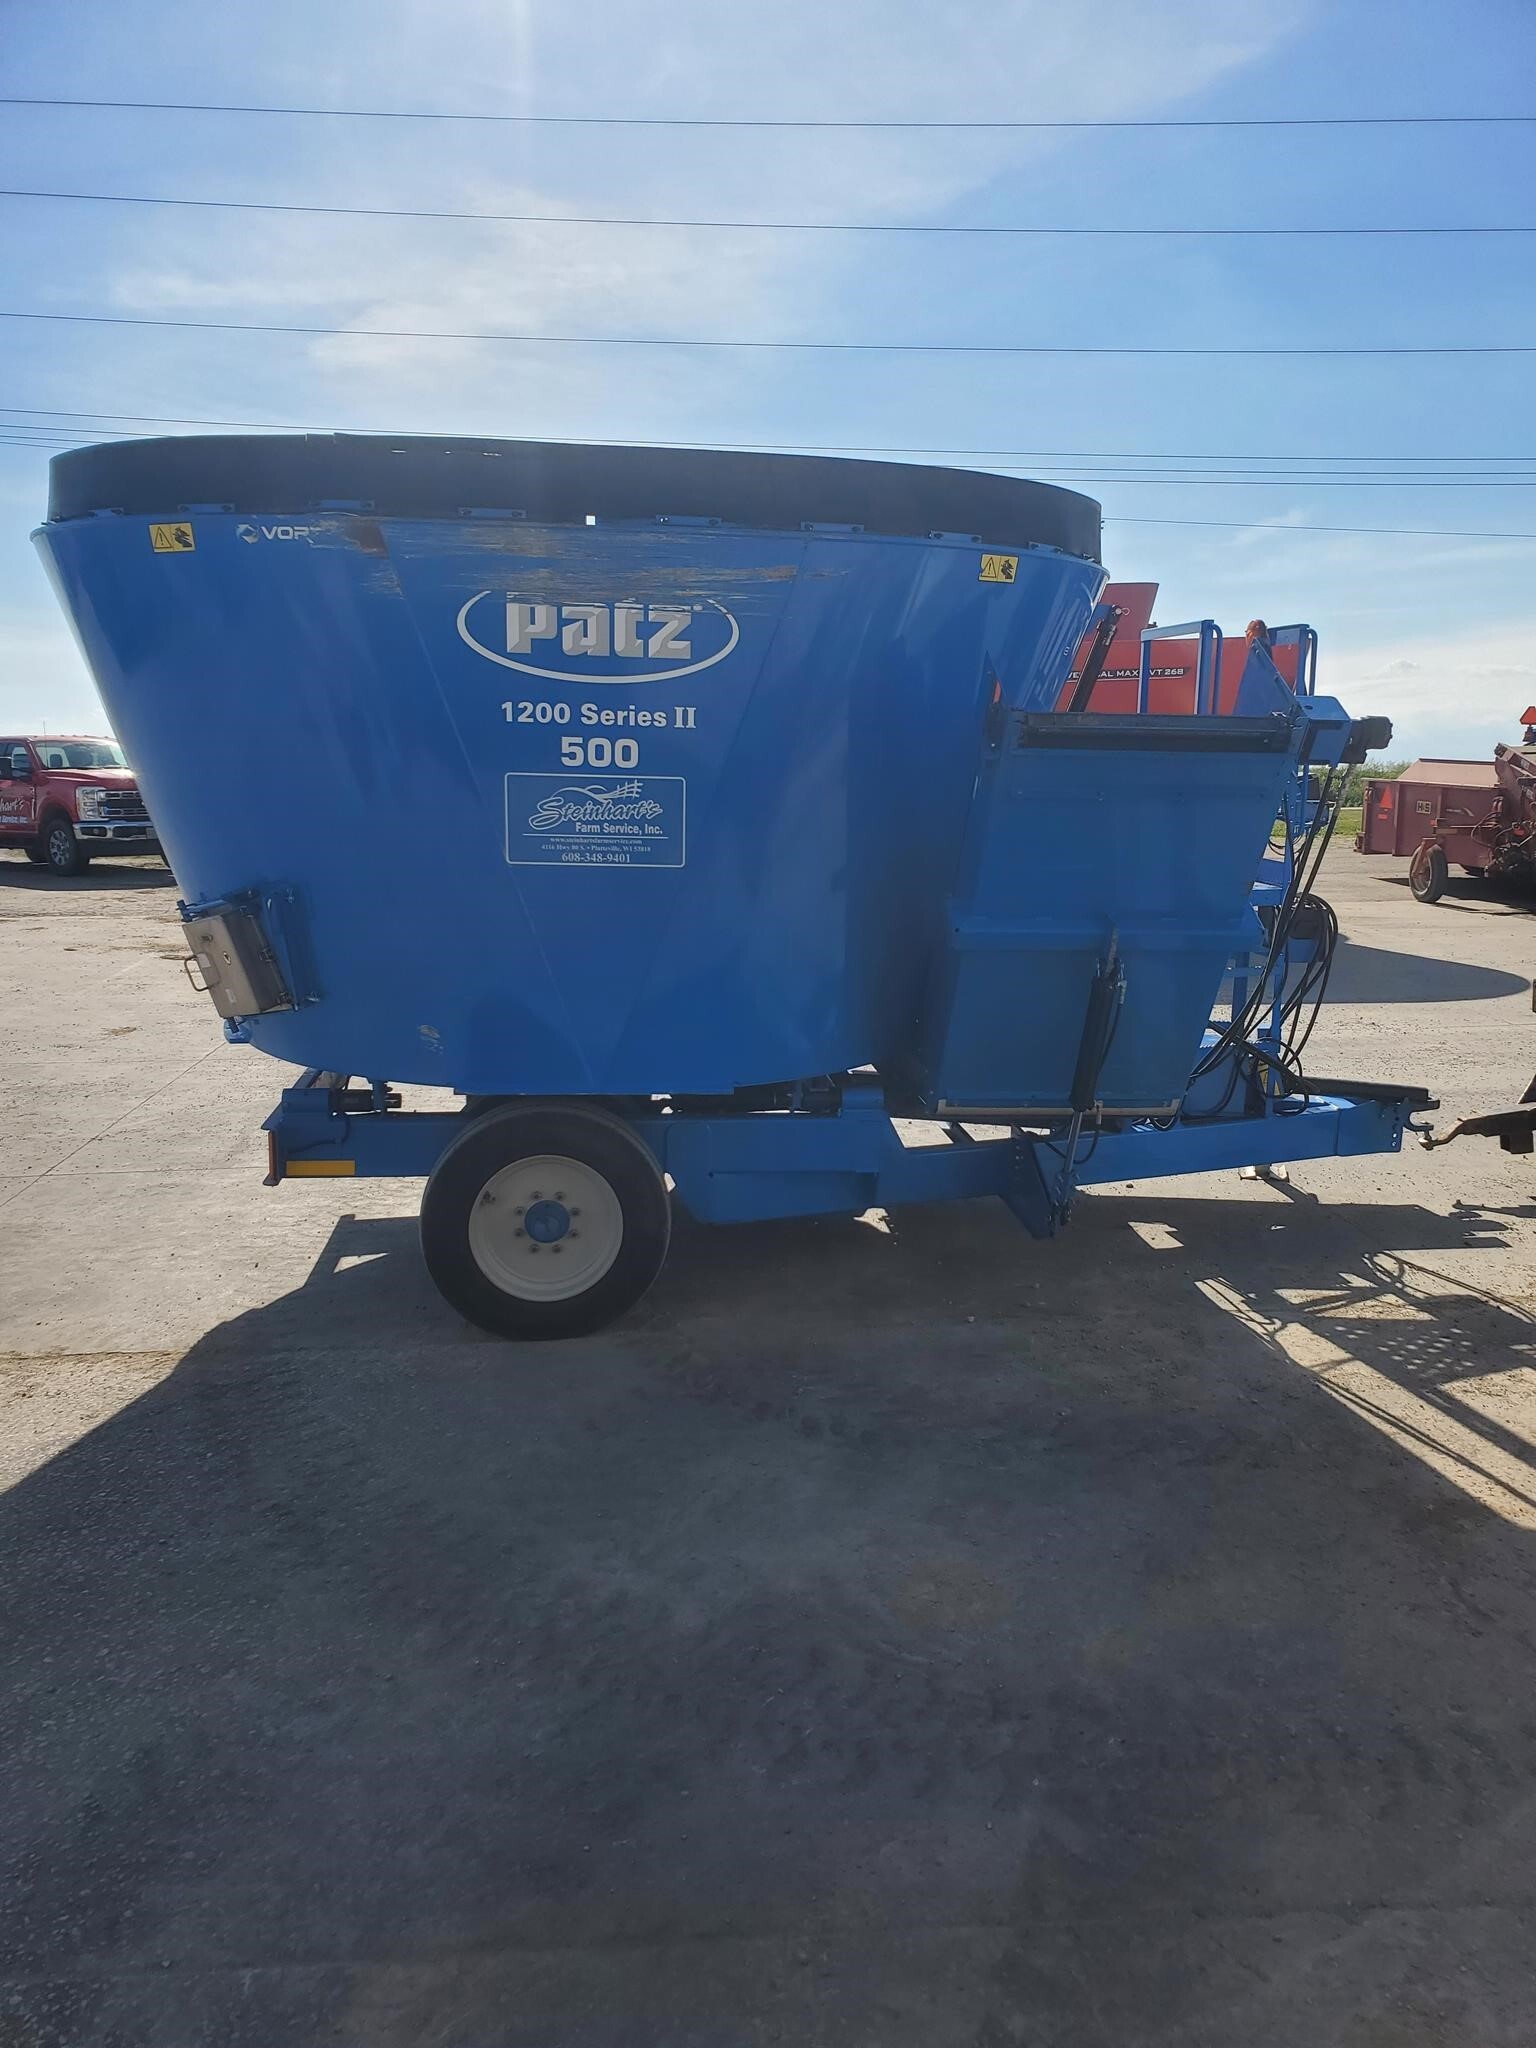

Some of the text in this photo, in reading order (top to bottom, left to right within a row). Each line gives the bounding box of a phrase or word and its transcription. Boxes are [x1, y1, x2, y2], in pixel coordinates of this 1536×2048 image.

[1149, 668, 1163, 676] VT
[1164, 668, 1184, 676] 268
[501, 701, 697, 728] 1200 Series II
[560, 736, 640, 768] 500
[528, 796, 663, 830] Steinhart's
[575, 822, 663, 835] Farm Service, Inc.
[561, 853, 631, 863] 608-348-9401
